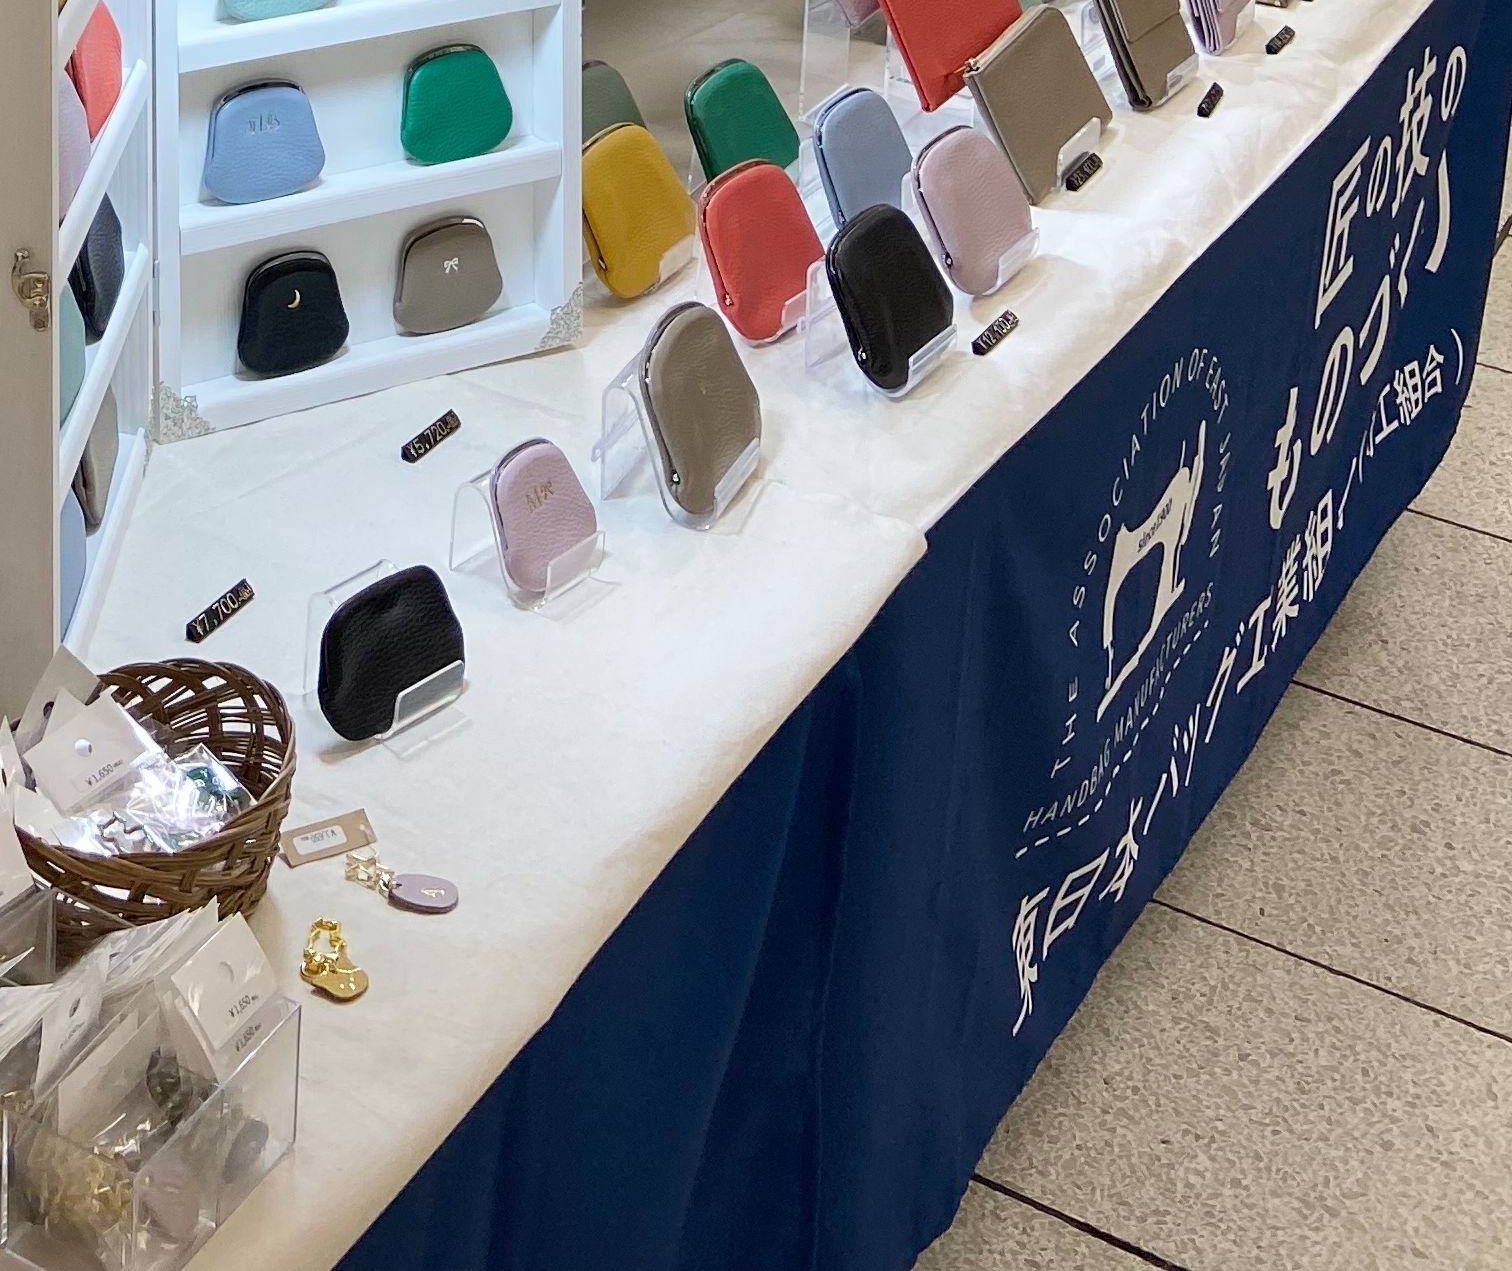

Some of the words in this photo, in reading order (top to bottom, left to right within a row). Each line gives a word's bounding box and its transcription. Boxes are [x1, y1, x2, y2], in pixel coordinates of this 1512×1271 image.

[1315, 46, 1467, 330] 匠の技の
[1049, 676, 1079, 779] THE
[1068, 356, 1184, 647] ASSOCIATION
[1187, 347, 1209, 383] OF
[1204, 355, 1229, 425] EAST
[1022, 738, 1111, 833] HANDBAG
[1113, 581, 1214, 749] MANUFACTURERS
